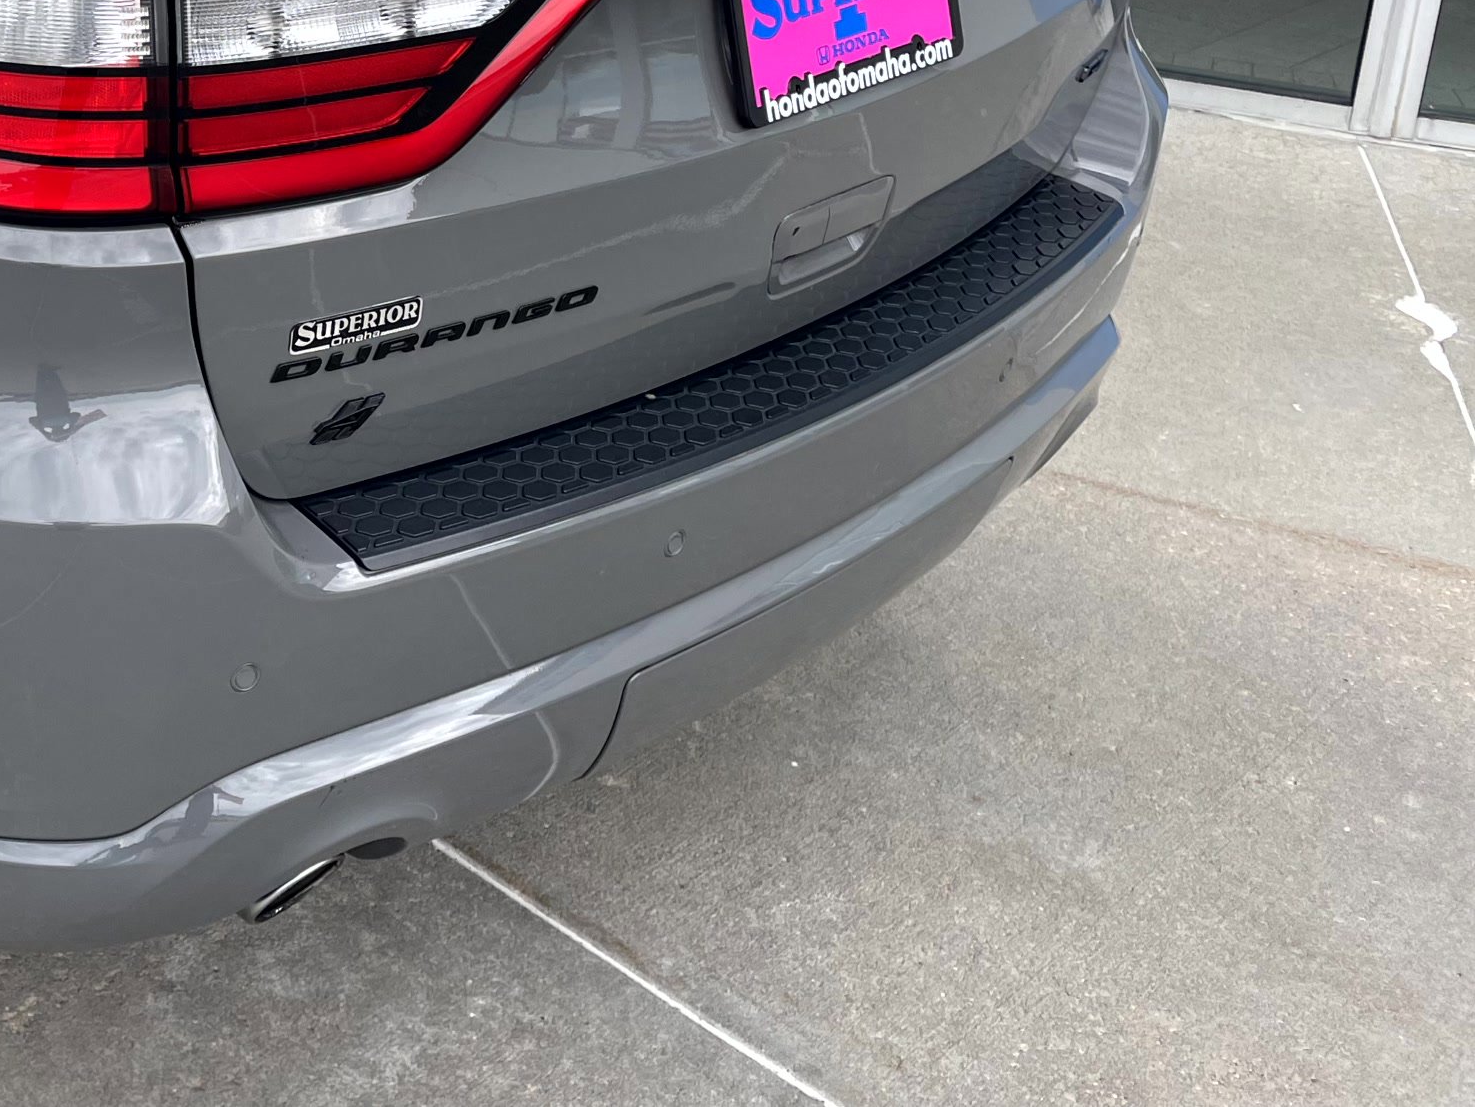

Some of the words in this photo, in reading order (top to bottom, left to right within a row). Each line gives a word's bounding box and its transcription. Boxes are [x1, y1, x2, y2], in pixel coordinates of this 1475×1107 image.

[832, 28, 890, 58] HONDA
[763, 38, 954, 123] hondaofomaha.com
[269, 285, 600, 384] DURANGO
[294, 299, 420, 348] SUPERIOR
[330, 329, 381, 348] Omaha
